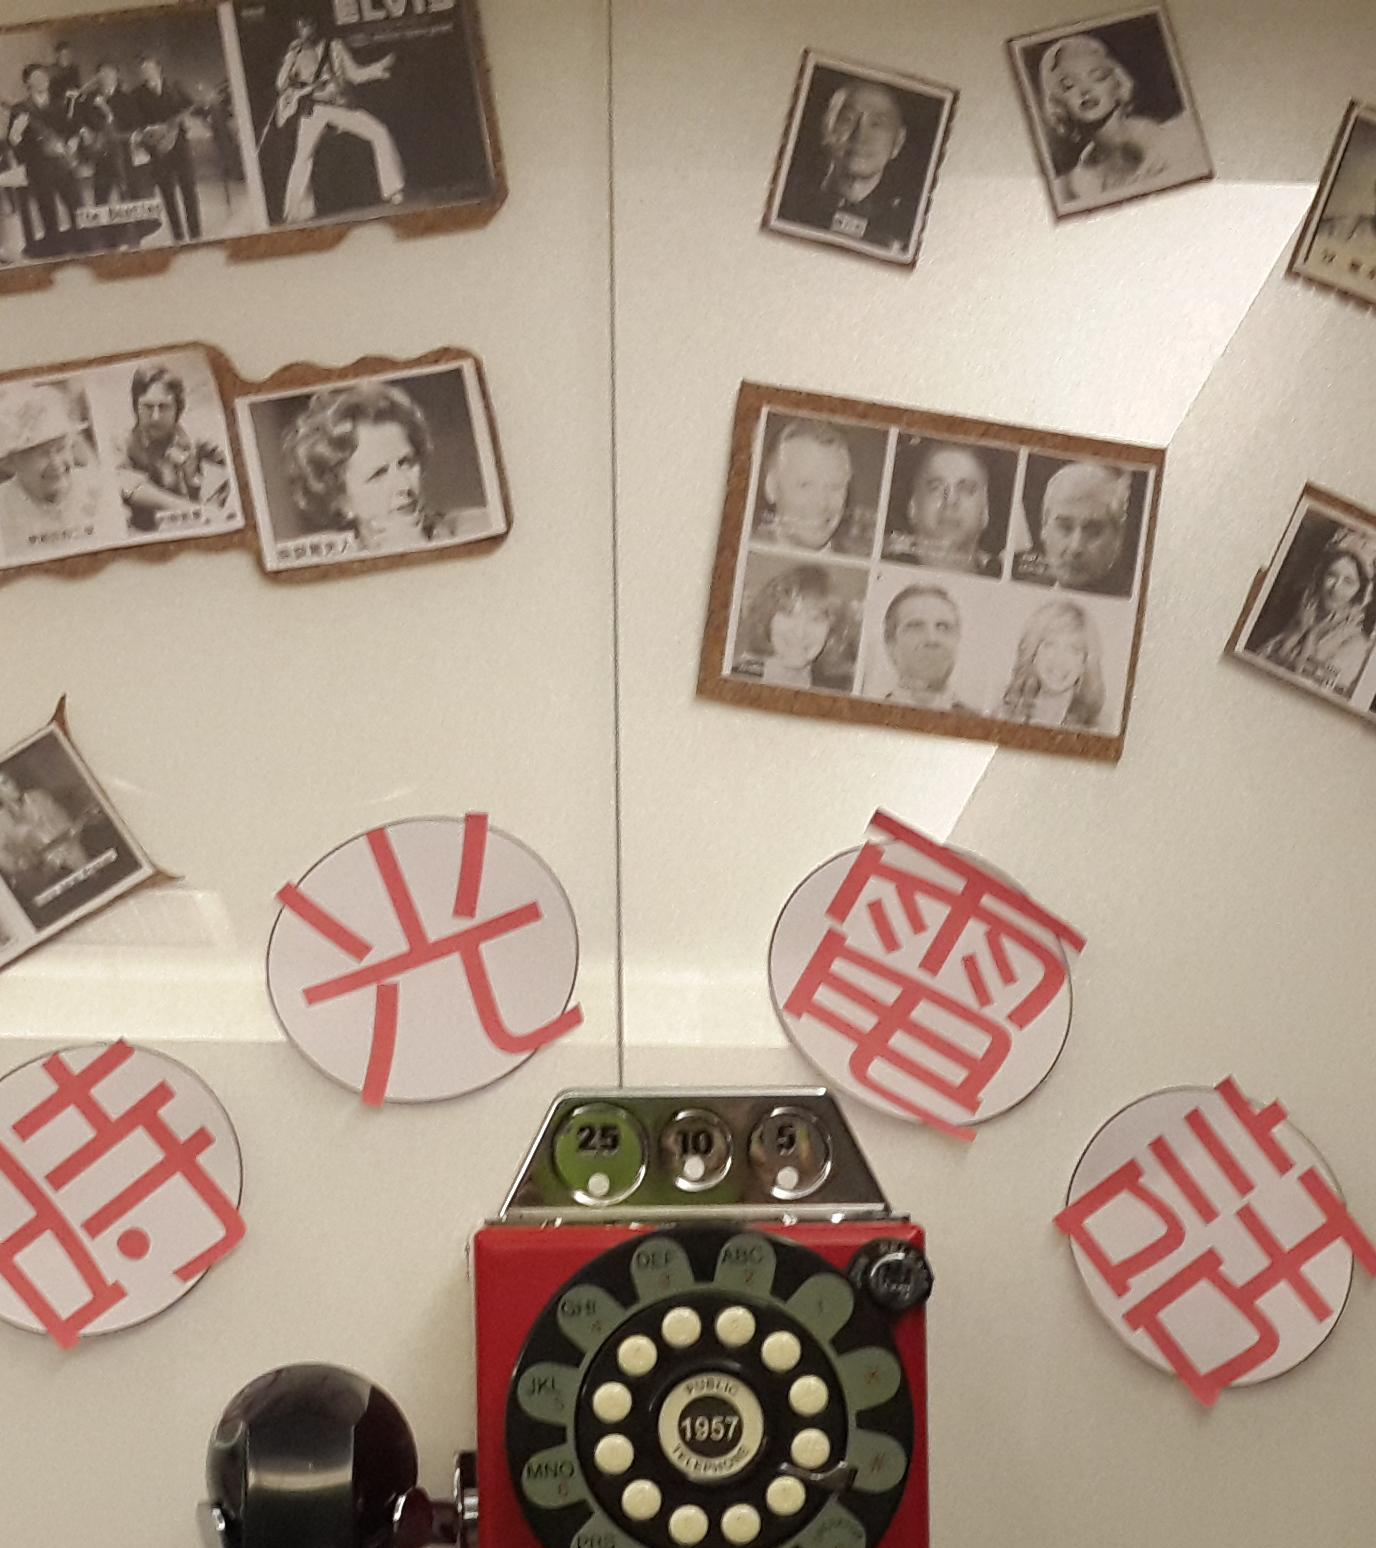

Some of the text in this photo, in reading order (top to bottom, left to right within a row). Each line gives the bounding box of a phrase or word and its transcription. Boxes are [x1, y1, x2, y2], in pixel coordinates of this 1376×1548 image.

[274, 811, 584, 1109] 光
[781, 807, 1088, 1144] 電
[577, 1124, 797, 1156] 25 10 5
[721, 1247, 763, 1265] ABC
[685, 1376, 738, 1397] PUBLIC
[679, 1415, 740, 1442] 1957
